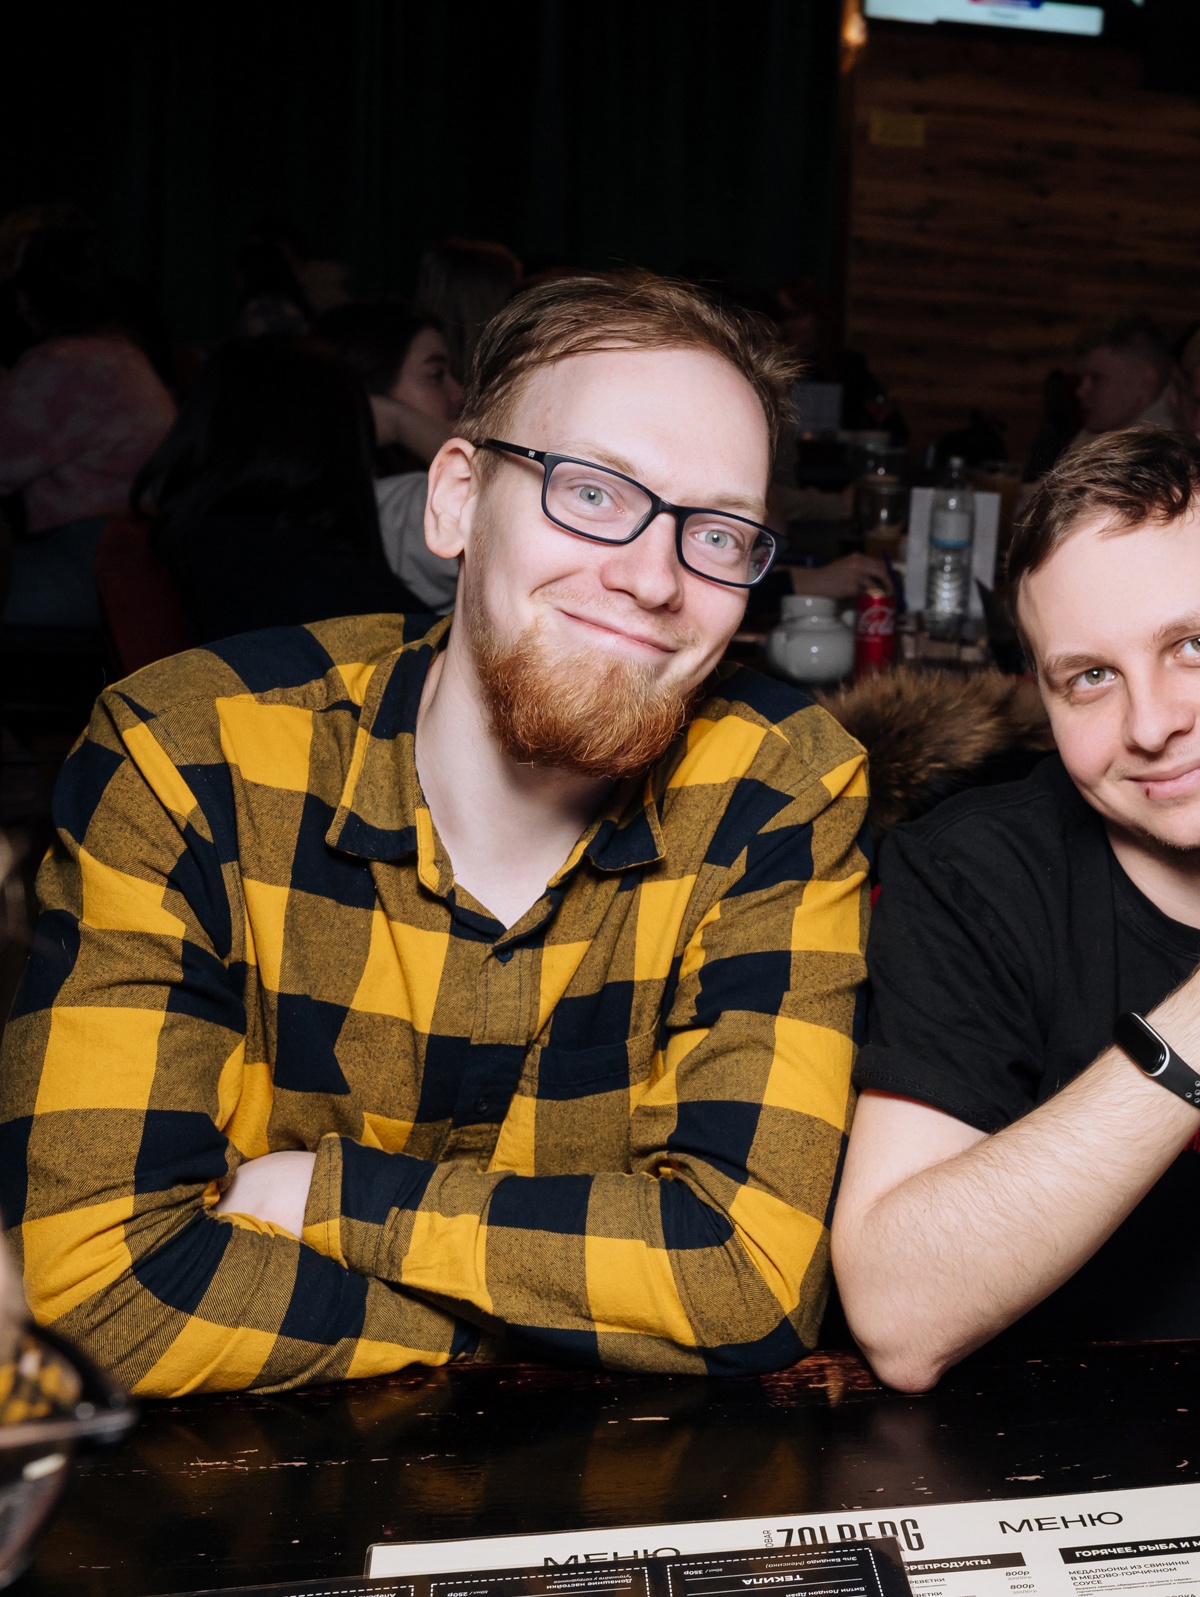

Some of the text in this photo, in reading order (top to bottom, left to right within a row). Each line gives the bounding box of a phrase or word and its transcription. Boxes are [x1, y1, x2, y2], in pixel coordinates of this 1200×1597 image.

[998, 1511, 1123, 1534] МЕНЮ
[1074, 1546, 1137, 1558] ГОРЯЧЕЕ,
[1139, 1542, 1176, 1552] РЫБА
[1179, 1541, 1191, 1549] И
[905, 1558, 991, 1571] ОРЕПРОДУКТЫ
[1068, 1566, 1127, 1575] МЕДАЛЬОНЫ
[1143, 1560, 1190, 1568] СВИНИНЫ
[741, 1574, 804, 1585] ТЕКИЛА
[1079, 1567, 1177, 1580] МЕДОВО-ГОРЧИЧНОМ
[546, 1577, 633, 1590] Домашние настойки
